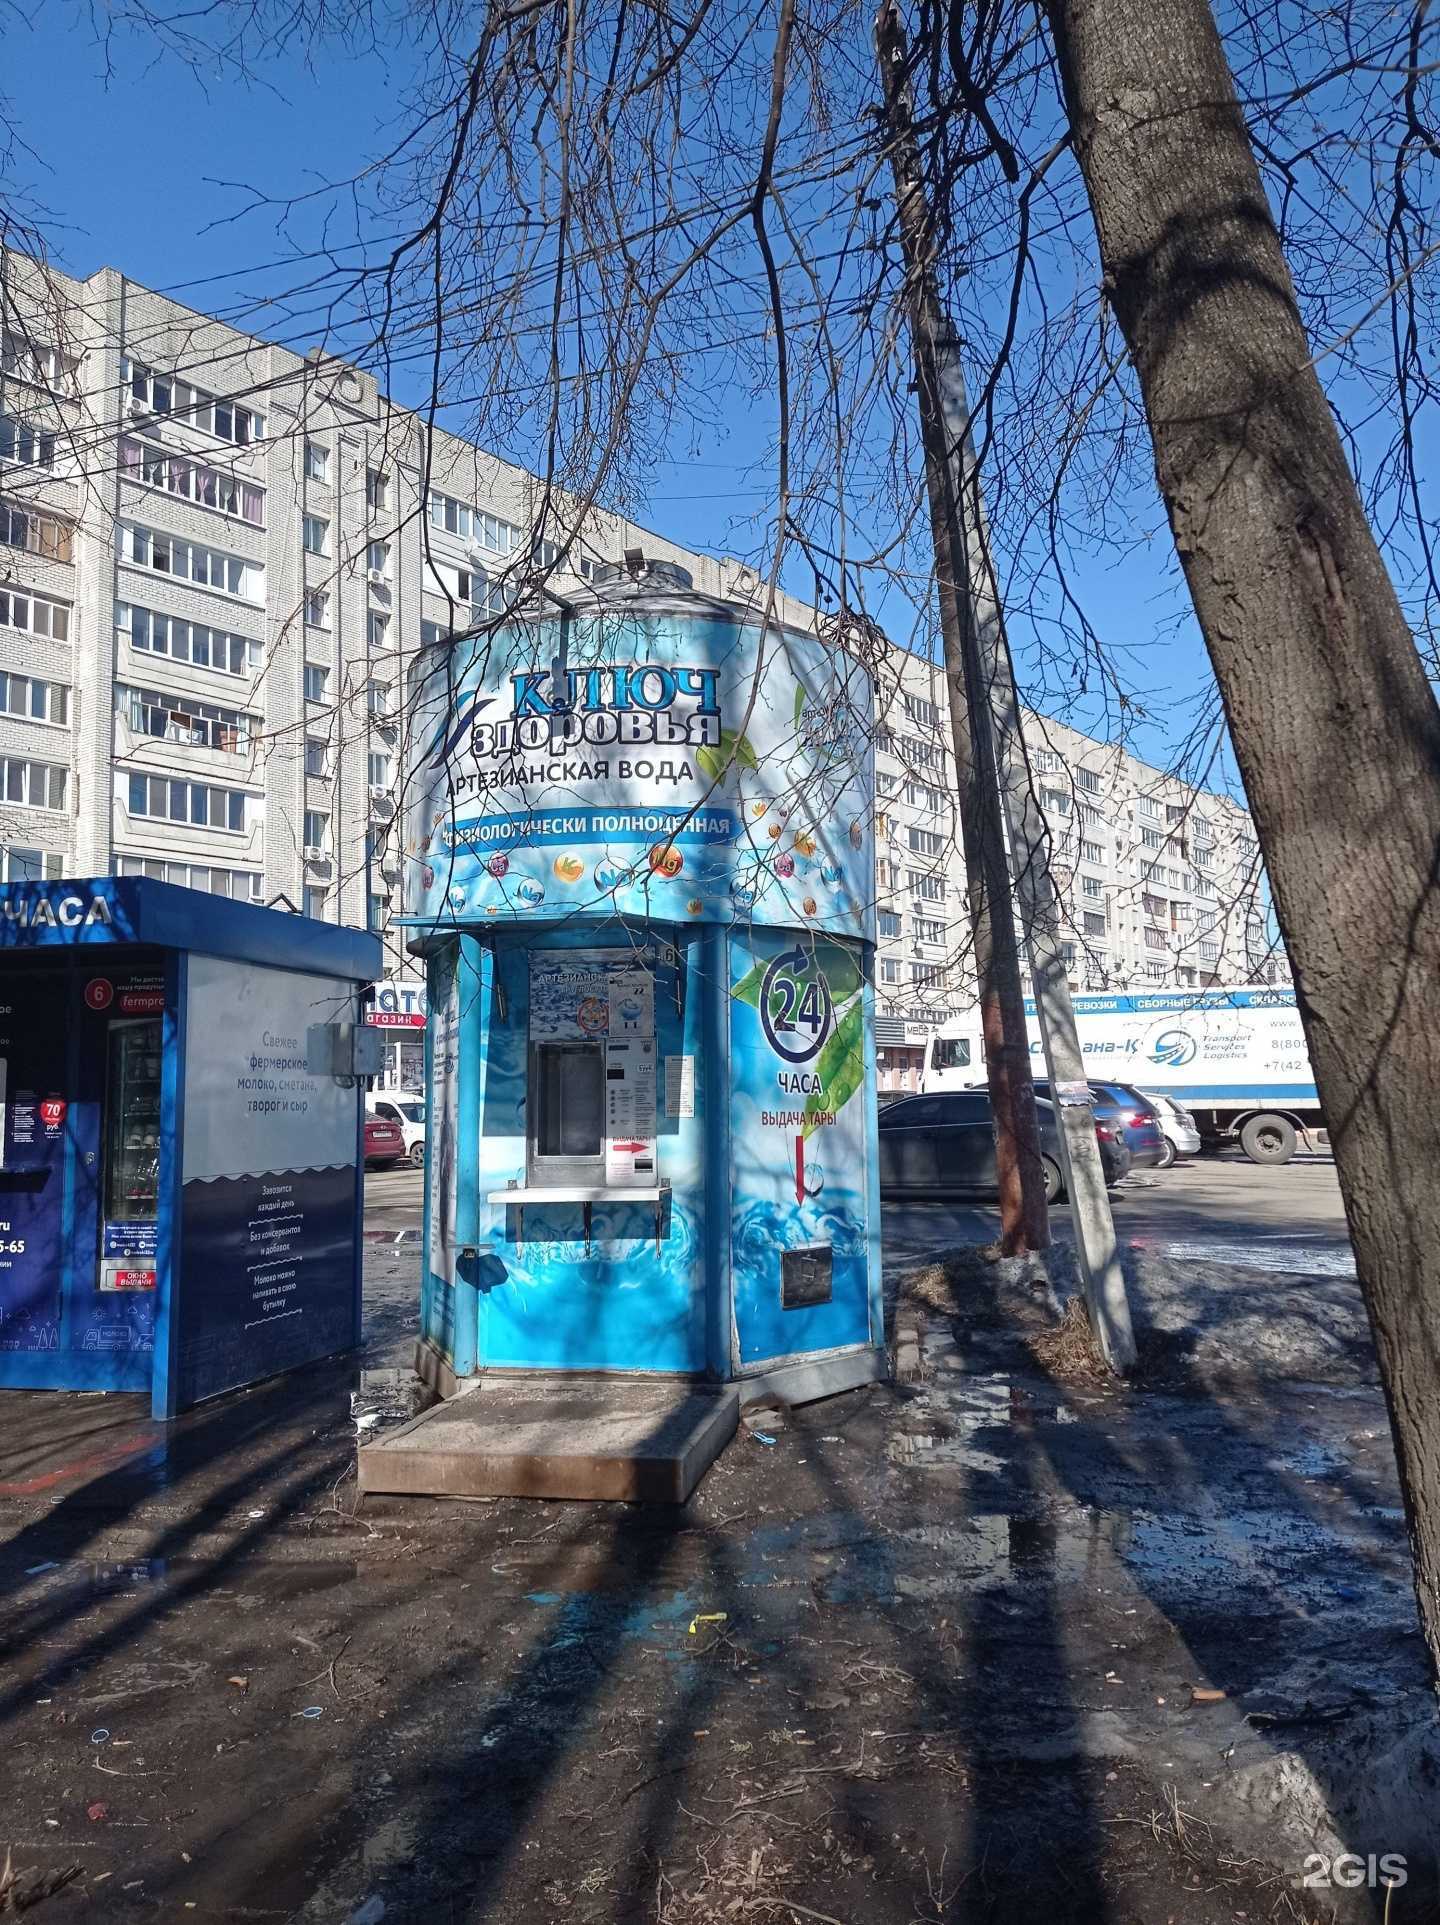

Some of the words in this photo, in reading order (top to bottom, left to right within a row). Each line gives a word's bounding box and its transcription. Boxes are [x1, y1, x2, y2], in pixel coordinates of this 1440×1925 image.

[510, 665, 720, 717] КЛЮЧ
[446, 761, 609, 797] АРТЕЗИАНСКАЯ
[618, 761, 694, 785] ВОДА
[443, 816, 586, 847] ФИЗИОЛОГИЧЕСКИ
[592, 815, 730, 834] ПОЛНОЦЕННАЯ
[4, 896, 112, 928] ЧАСА
[94, 986, 103, 1001] 6
[774, 979, 822, 1034] 24
[1138, 998, 1192, 1008] СБОРНЫЕ
[366, 1013, 412, 1024] агазин
[262, 1031, 298, 1049] Свежее
[1203, 1035, 1252, 1043] Transport
[1204, 1043, 1246, 1052] Services
[250, 1051, 309, 1071] фермерское
[1203, 1052, 1248, 1060] Logistics
[238, 1078, 277, 1093] молоко,
[278, 1078, 318, 1093] сметана,
[778, 1073, 822, 1094] ЧАСА
[47, 1104, 60, 1116] 70
[248, 1100, 280, 1116] творог
[762, 1111, 806, 1128] ВЫДАЧА
[810, 1110, 837, 1126] ТАРЫ
[262, 1184, 293, 1196] Завозится
[257, 1199, 281, 1211] каждый
[281, 1200, 295, 1210] день
[250, 1230, 261, 1242] Без
[262, 1225, 301, 1239] консервантов
[265, 1242, 290, 1256] добавок
[254, 1273, 277, 1286] Молоко
[262, 1297, 287, 1312] бутылку
